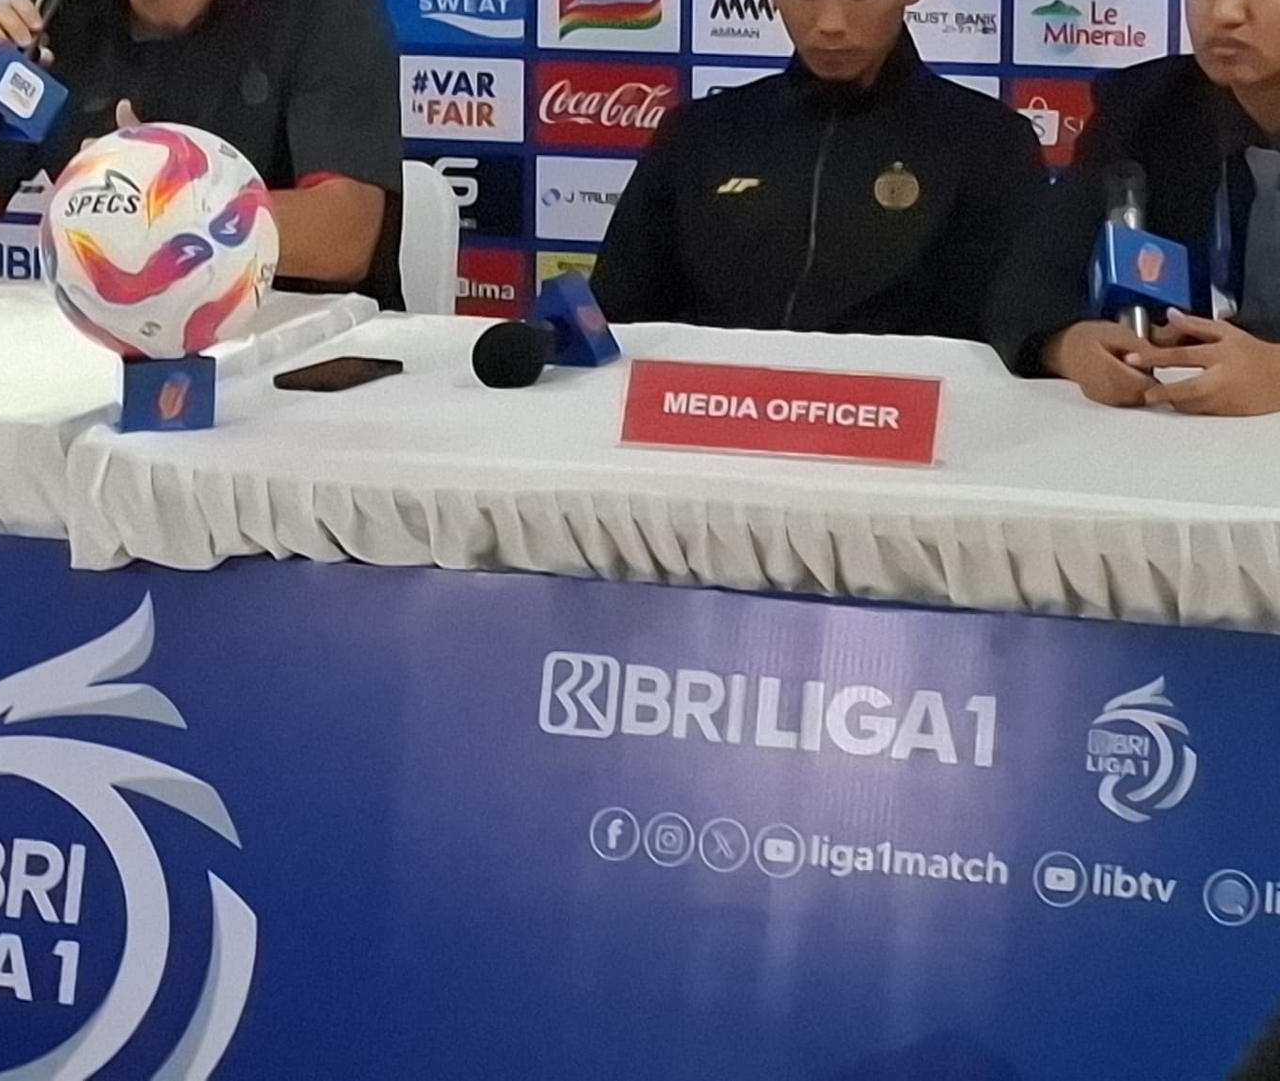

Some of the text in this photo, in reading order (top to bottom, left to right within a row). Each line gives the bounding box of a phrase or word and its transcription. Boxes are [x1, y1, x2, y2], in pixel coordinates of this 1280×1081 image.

[955, 13, 996, 26] BANK
[1091, 1, 1117, 25] Le
[1044, 23, 1145, 47] Minerale
[412, 71, 494, 98] #VAR
[426, 101, 495, 127] FAIR
[65, 193, 139, 217] SPECS
[663, 392, 899, 429] MEDIA OFFICER
[621, 664, 997, 767] BRI LIGA 1
[810, 834, 1008, 886] liga1match
[1093, 863, 1177, 904] libtv
[52, 940, 80, 1005] 1
